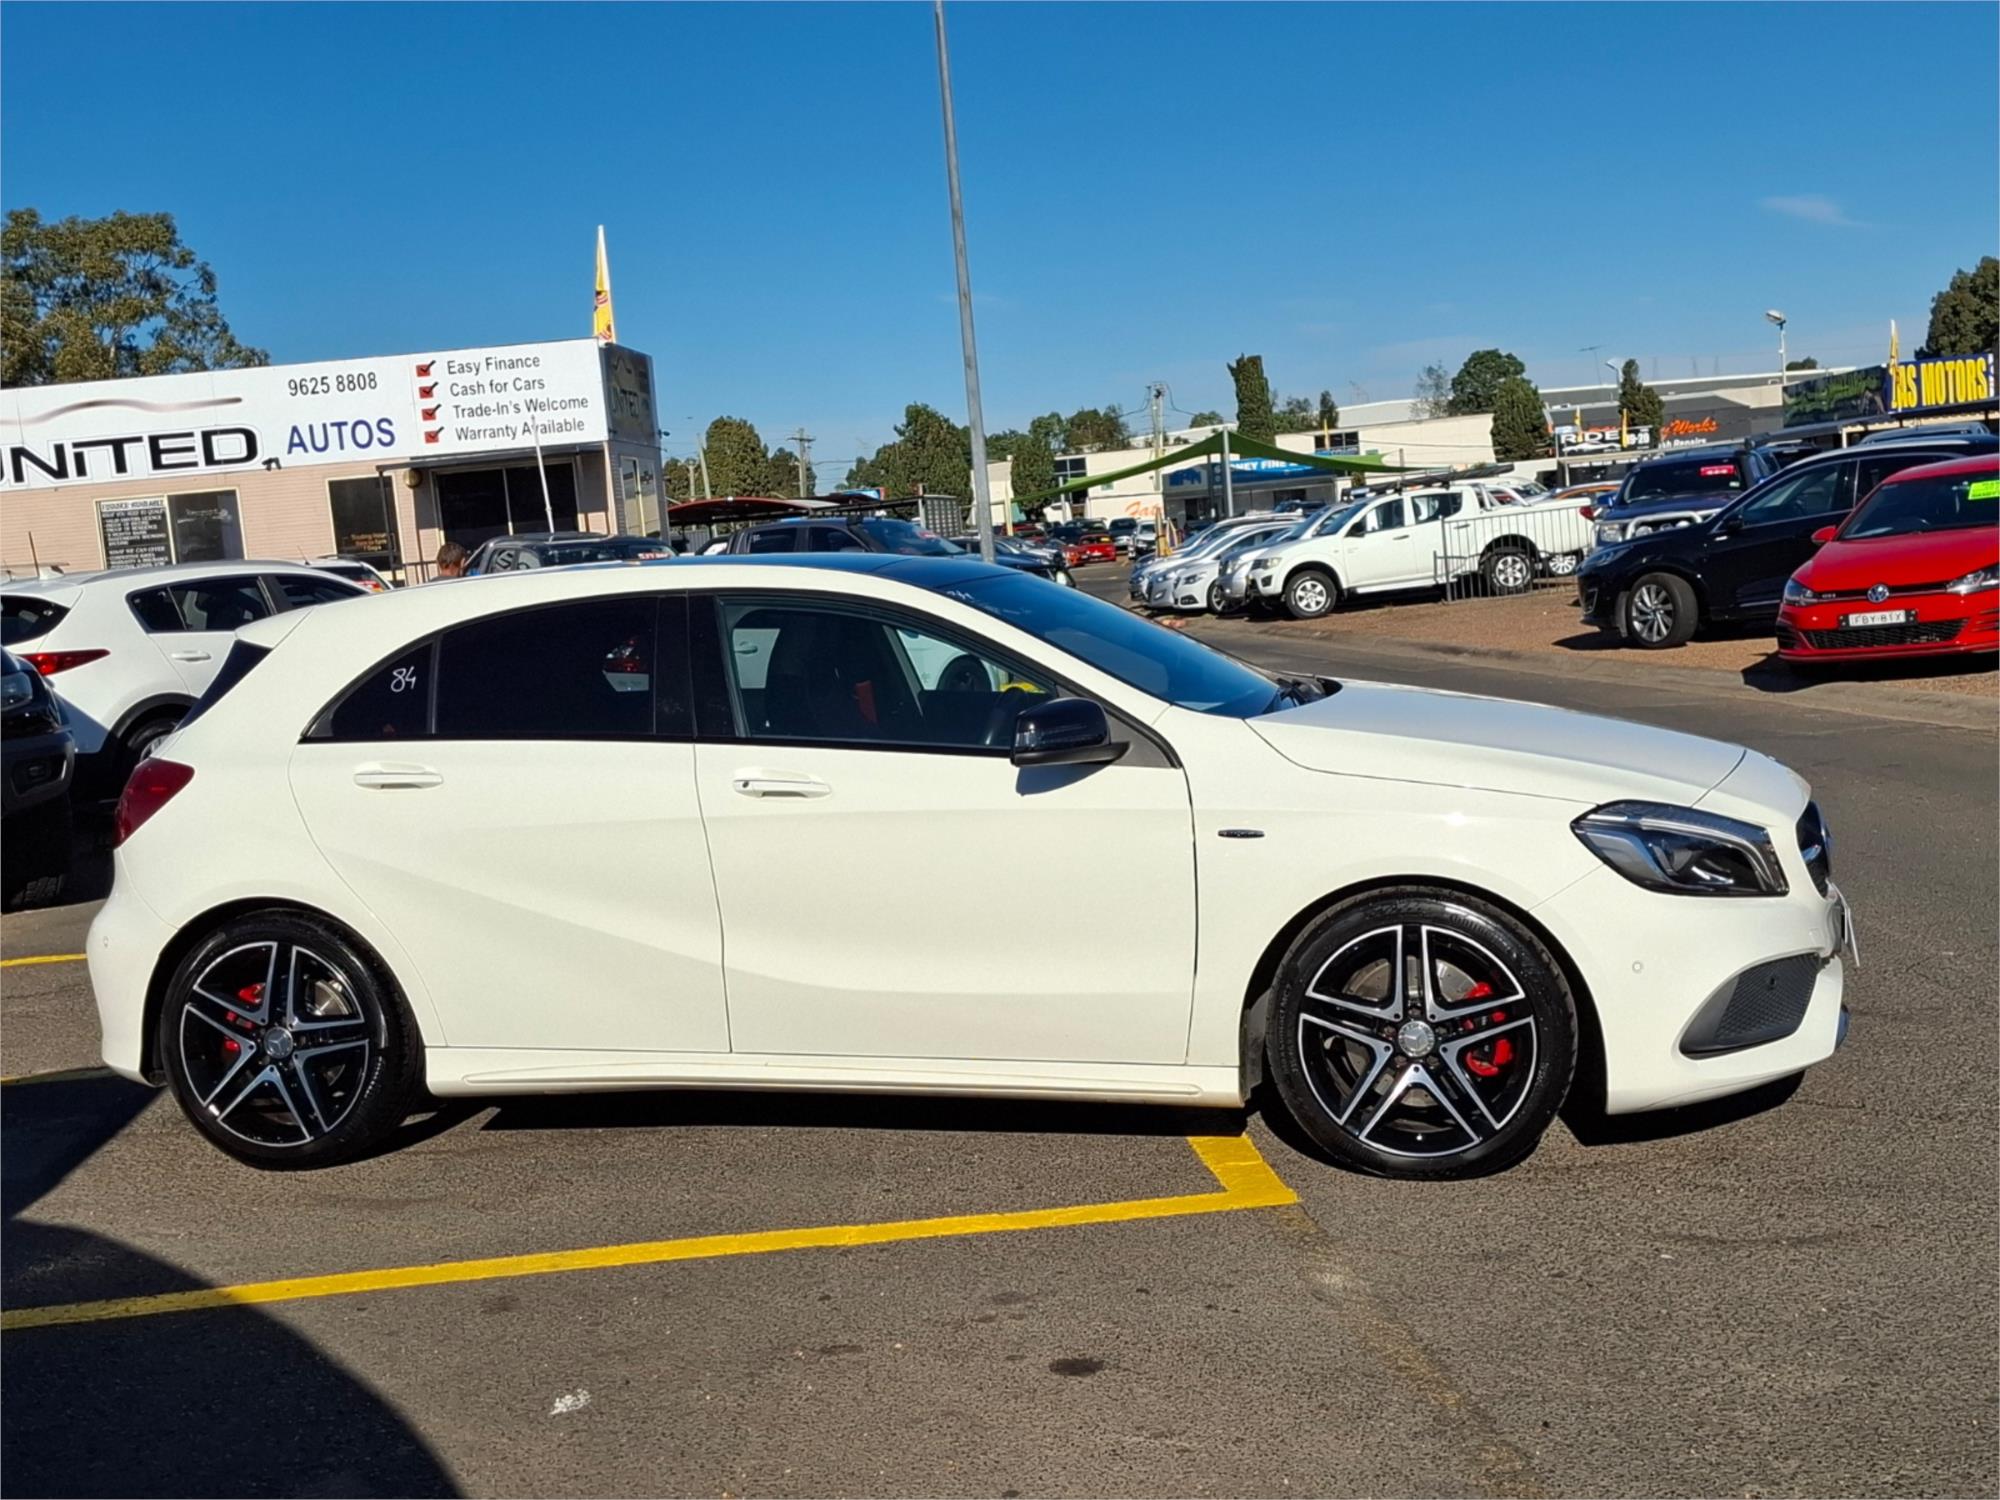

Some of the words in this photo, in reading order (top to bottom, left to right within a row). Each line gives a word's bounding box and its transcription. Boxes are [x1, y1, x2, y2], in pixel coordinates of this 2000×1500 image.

[447, 360, 481, 376] Easy
[485, 355, 541, 371] Finance
[288, 376, 331, 396] 9625
[336, 371, 378, 392] 8808
[450, 379, 485, 397] Cash
[489, 379, 508, 393] for
[513, 377, 545, 391] Cars
[1920, 356, 1988, 406] MOTORS
[452, 400, 521, 419] Trade-In's
[524, 397, 589, 412] Welcome
[287, 417, 396, 454] AUTOS
[455, 424, 517, 440] Warranty
[522, 417, 585, 435] Available
[1560, 429, 1621, 444] RDE
[390, 666, 417, 692] 84
